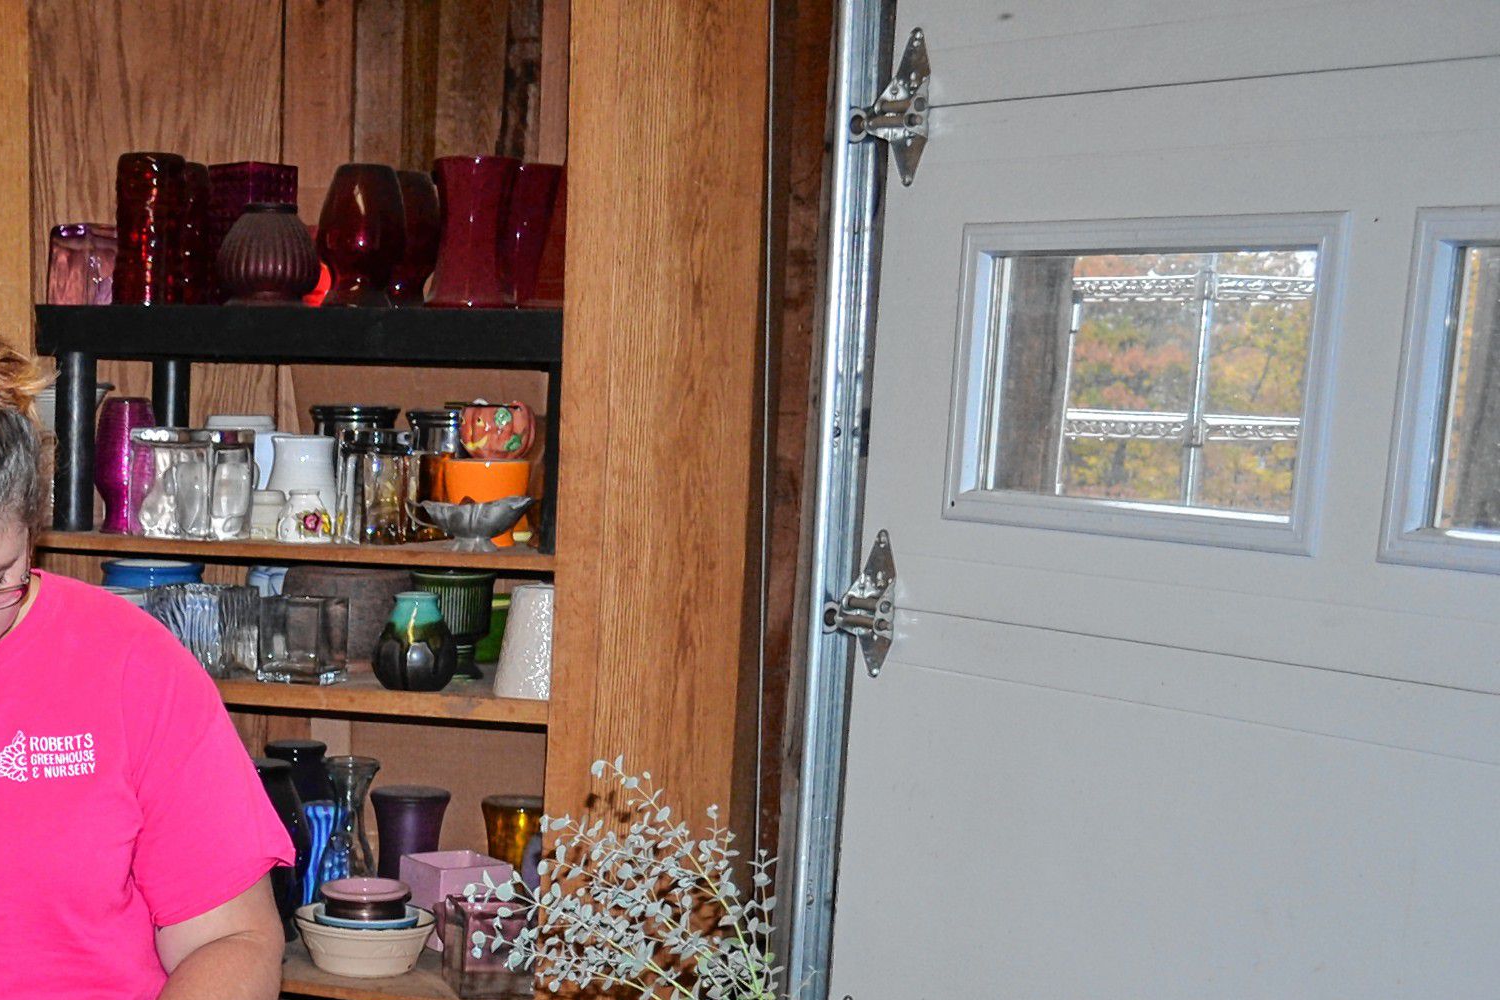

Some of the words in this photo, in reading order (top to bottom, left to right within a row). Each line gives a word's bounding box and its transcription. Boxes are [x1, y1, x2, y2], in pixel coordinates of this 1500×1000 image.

[29, 733, 94, 751] ROBERTS
[30, 749, 96, 766] GREENHOUSE
[44, 762, 96, 778] NURSERY
